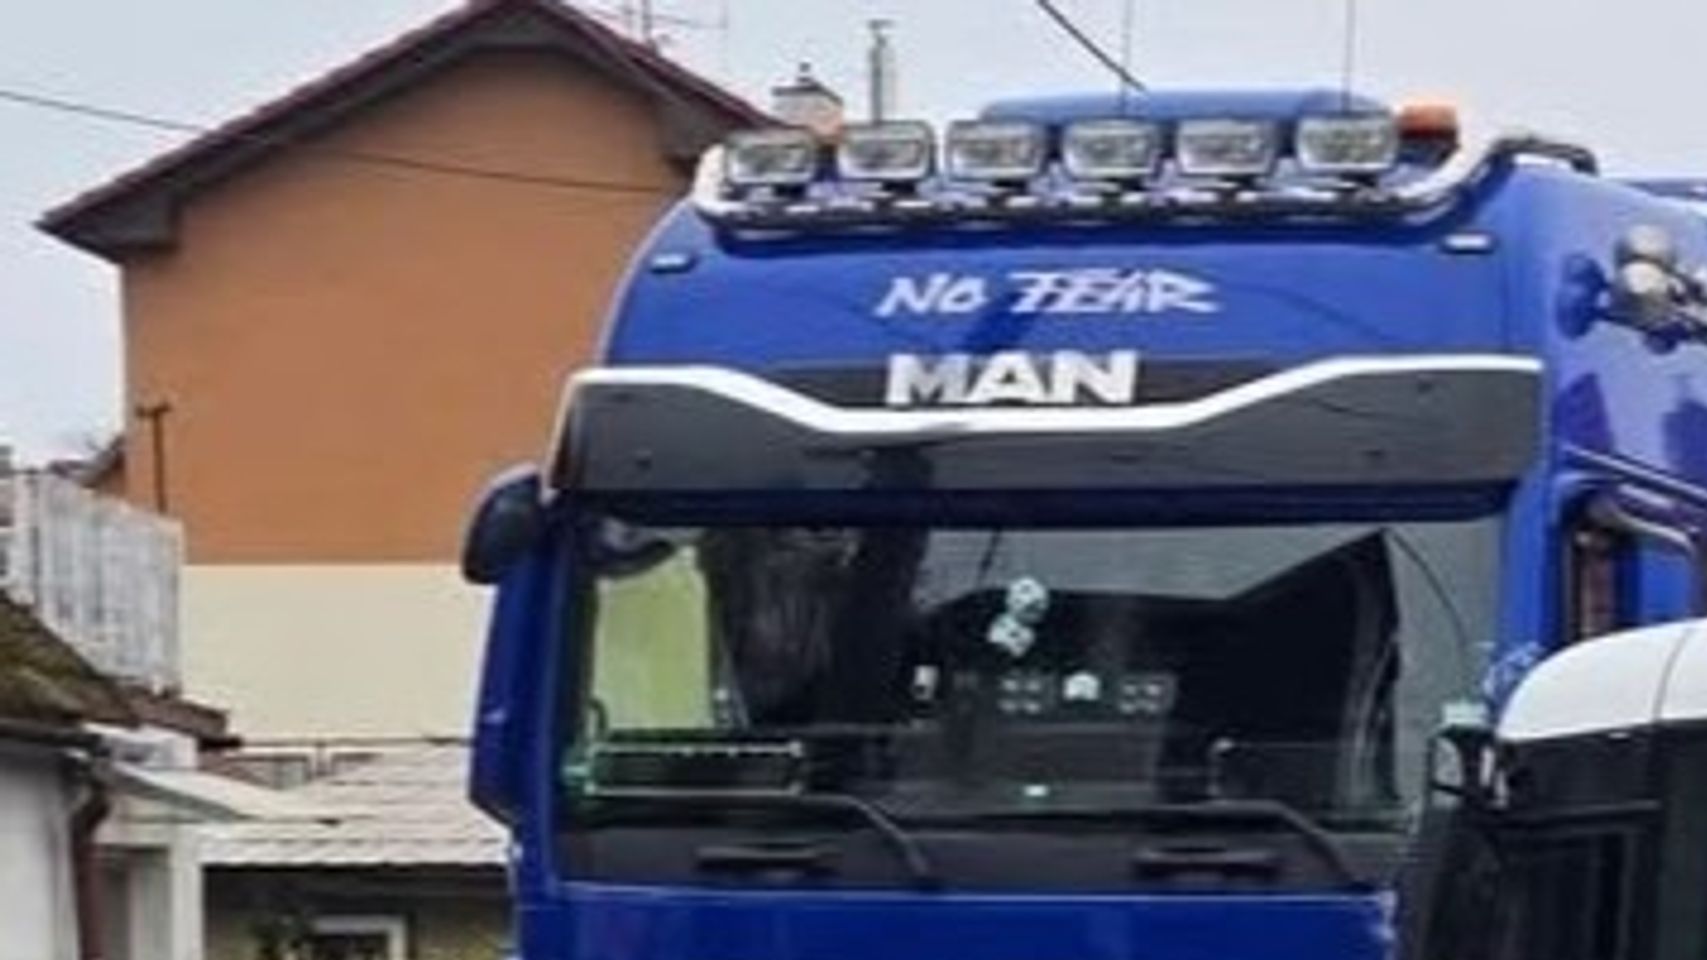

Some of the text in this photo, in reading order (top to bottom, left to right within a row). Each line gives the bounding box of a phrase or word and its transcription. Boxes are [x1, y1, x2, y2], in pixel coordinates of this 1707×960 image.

[875, 268, 1220, 316] NO FEAR
[886, 350, 1138, 405] MAN
